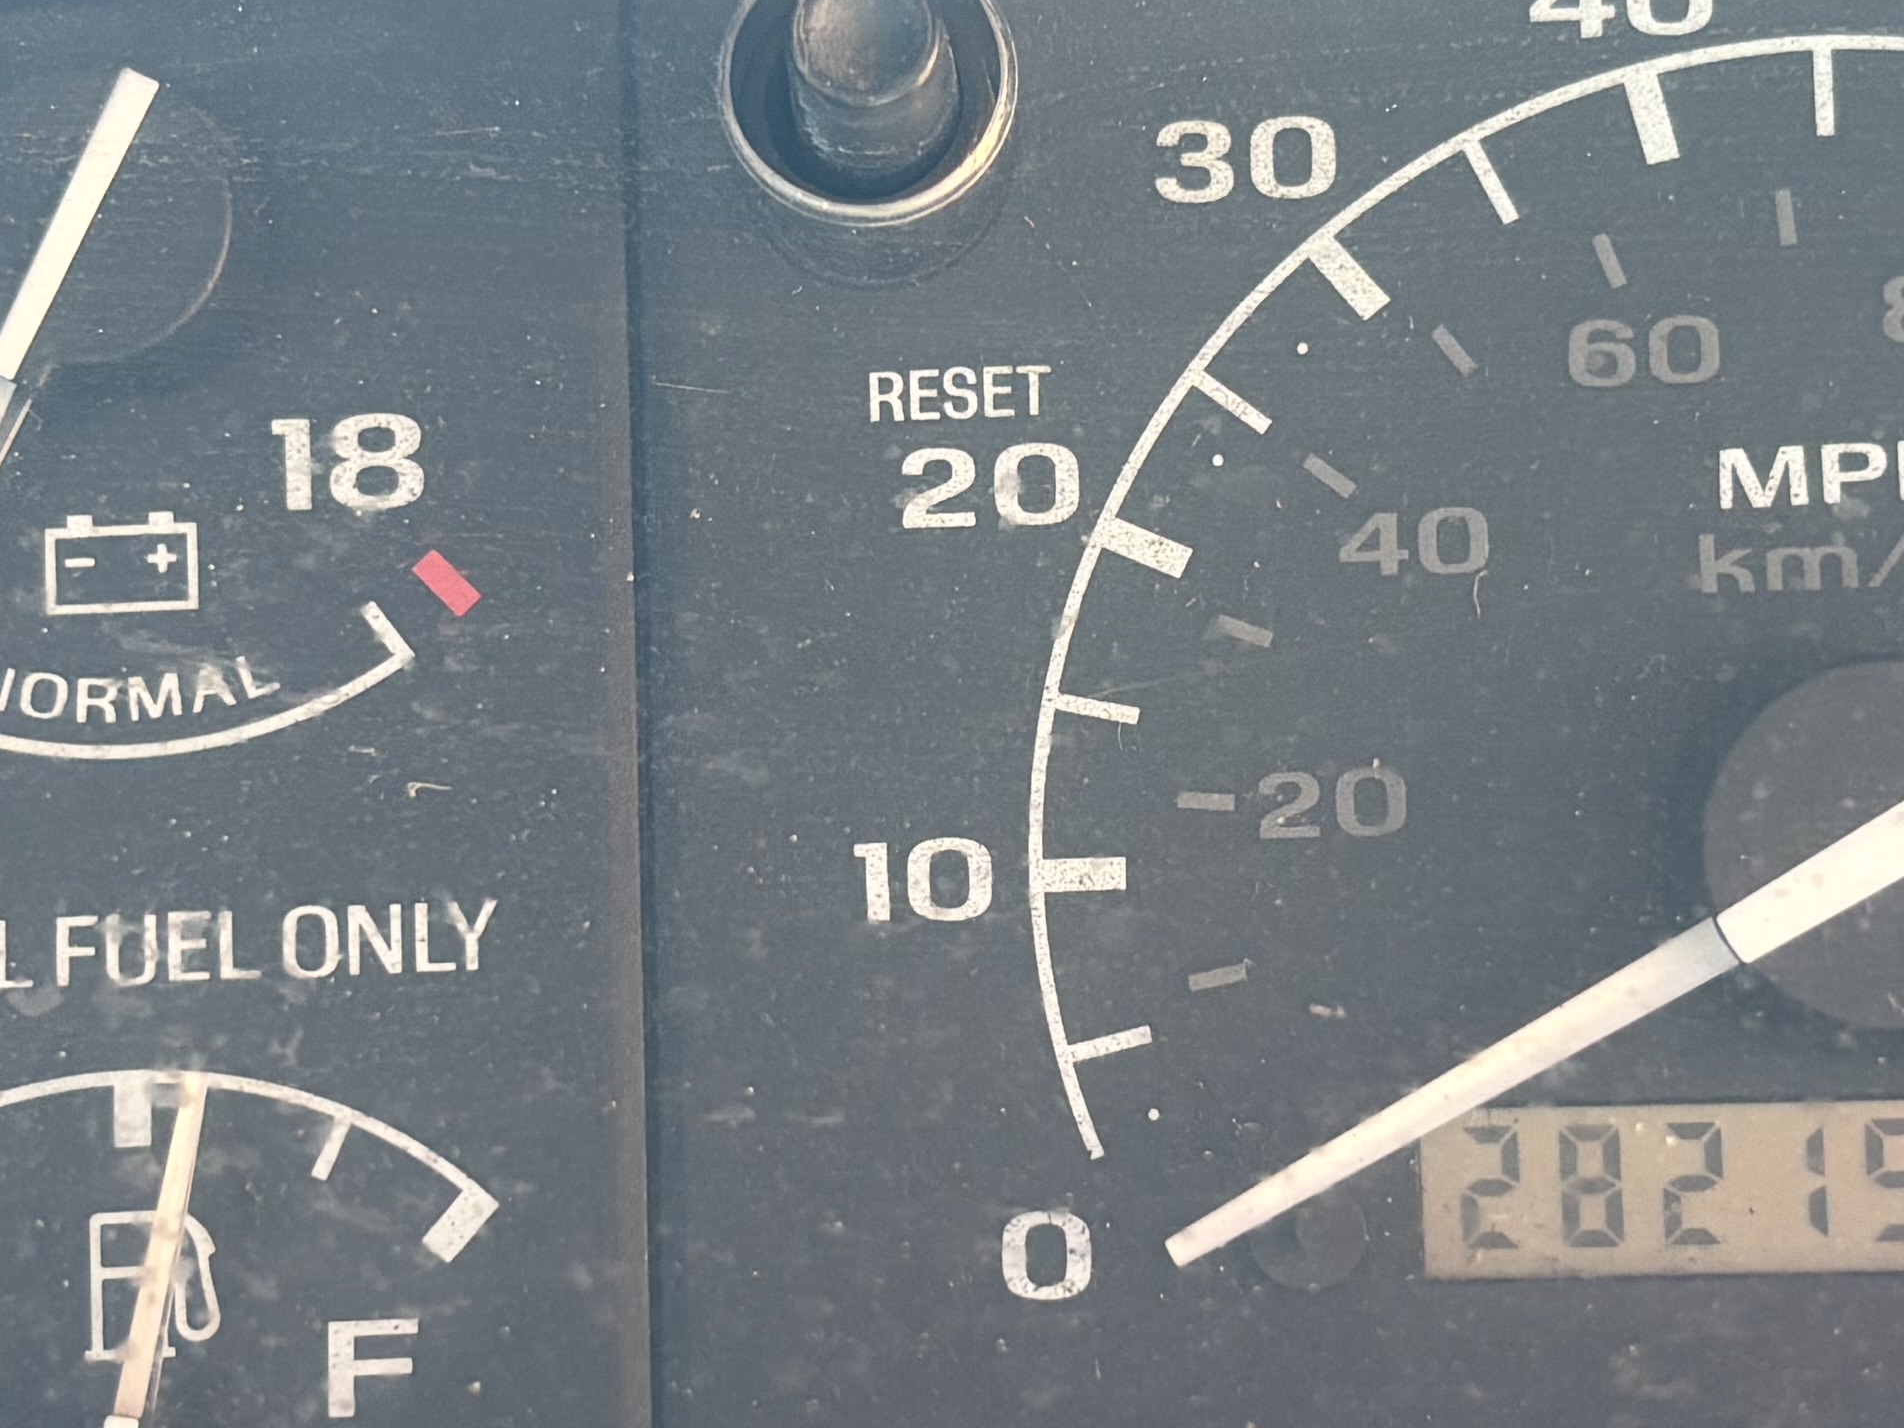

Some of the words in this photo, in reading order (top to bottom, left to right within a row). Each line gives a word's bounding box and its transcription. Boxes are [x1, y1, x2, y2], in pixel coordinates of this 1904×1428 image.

[1155, 116, 1337, 203] 30
[868, 365, 1051, 422] RESET
[1567, 316, 1720, 388] 60
[271, 412, 424, 510] 18
[901, 442, 1080, 529] 20
[1338, 507, 1490, 576] 40
[1258, 768, 1407, 839] 20
[853, 837, 993, 922] 10
[55, 909, 261, 987] FUEL
[282, 898, 498, 981] ONLY
[1001, 1210, 1092, 1300] 0
[327, 1318, 419, 1418] F
